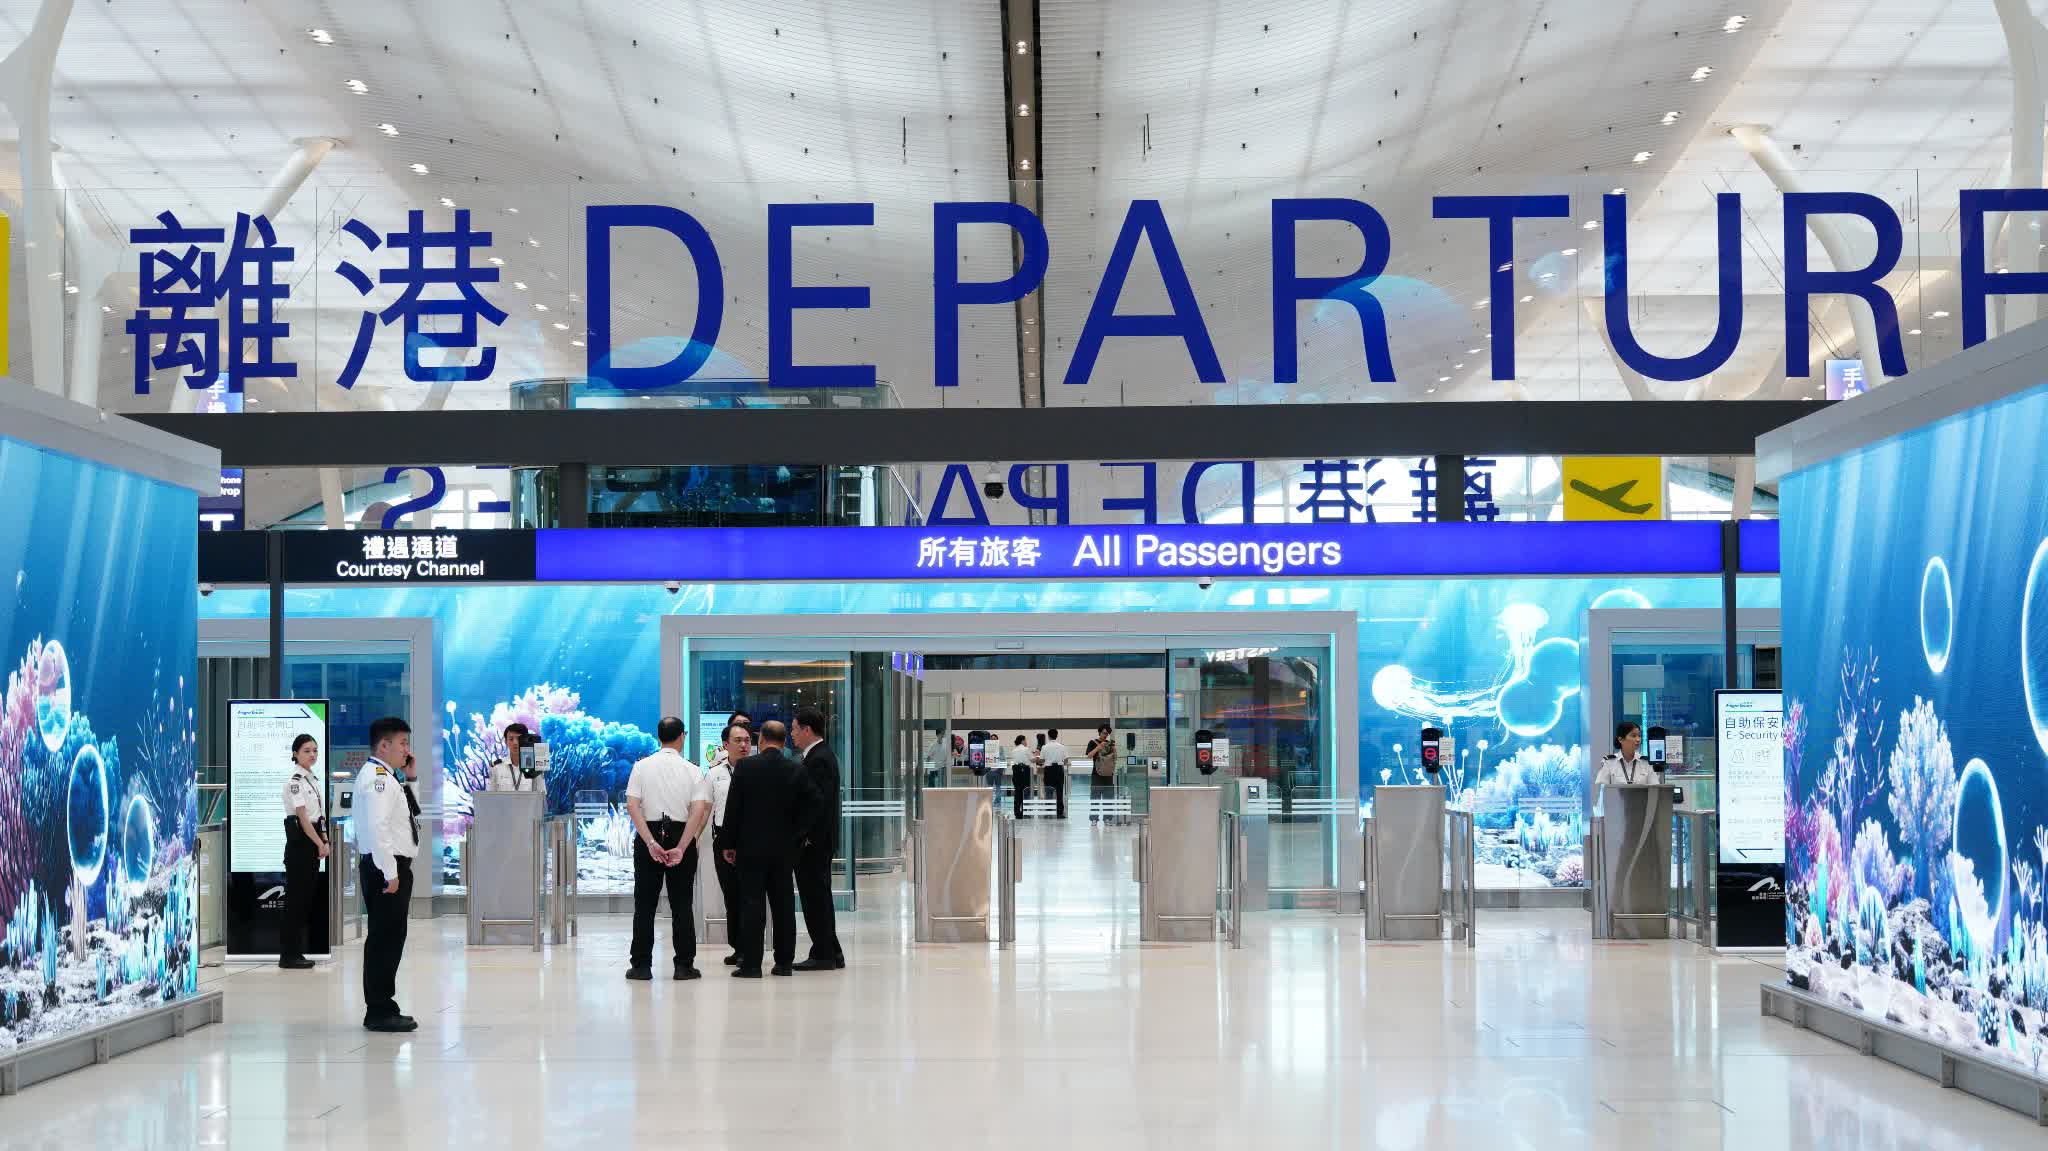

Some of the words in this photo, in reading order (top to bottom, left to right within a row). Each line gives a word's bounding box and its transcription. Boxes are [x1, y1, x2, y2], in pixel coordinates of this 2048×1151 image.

[126, 209, 508, 394] 離港
[221, 476, 241, 484] hone
[221, 486, 240, 497] rop
[363, 535, 458, 559] 禮遇通道
[916, 536, 1042, 567] 所有旅客
[1073, 535, 1121, 567] All
[1136, 535, 1342, 573] Passengers
[336, 560, 412, 580] Courtesy
[416, 560, 484, 577] Channel
[1725, 716, 1783, 729] 自助保安
